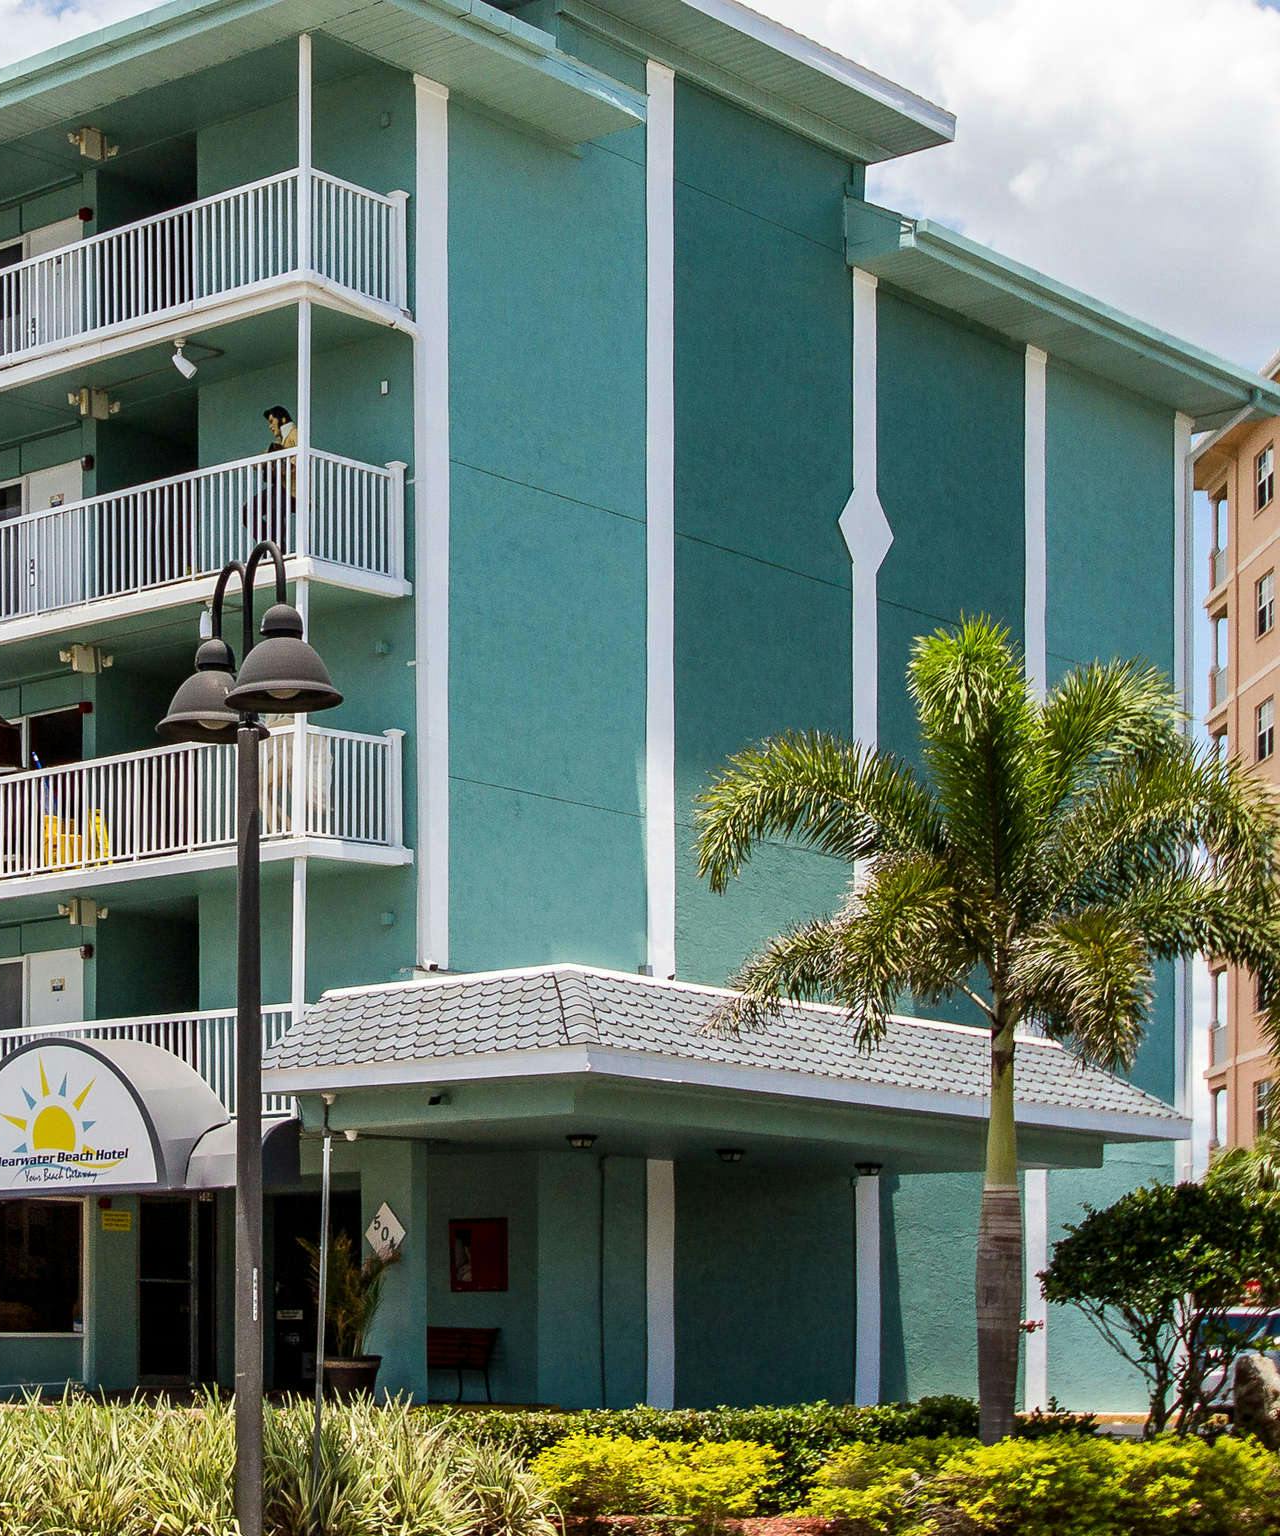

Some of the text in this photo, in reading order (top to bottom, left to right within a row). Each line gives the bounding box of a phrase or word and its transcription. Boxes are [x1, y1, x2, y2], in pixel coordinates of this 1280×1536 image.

[57, 1151, 93, 1163] Beach
[97, 1148, 129, 1161] Hotel
[25, 1166, 98, 1183] Your Beach Getaway
